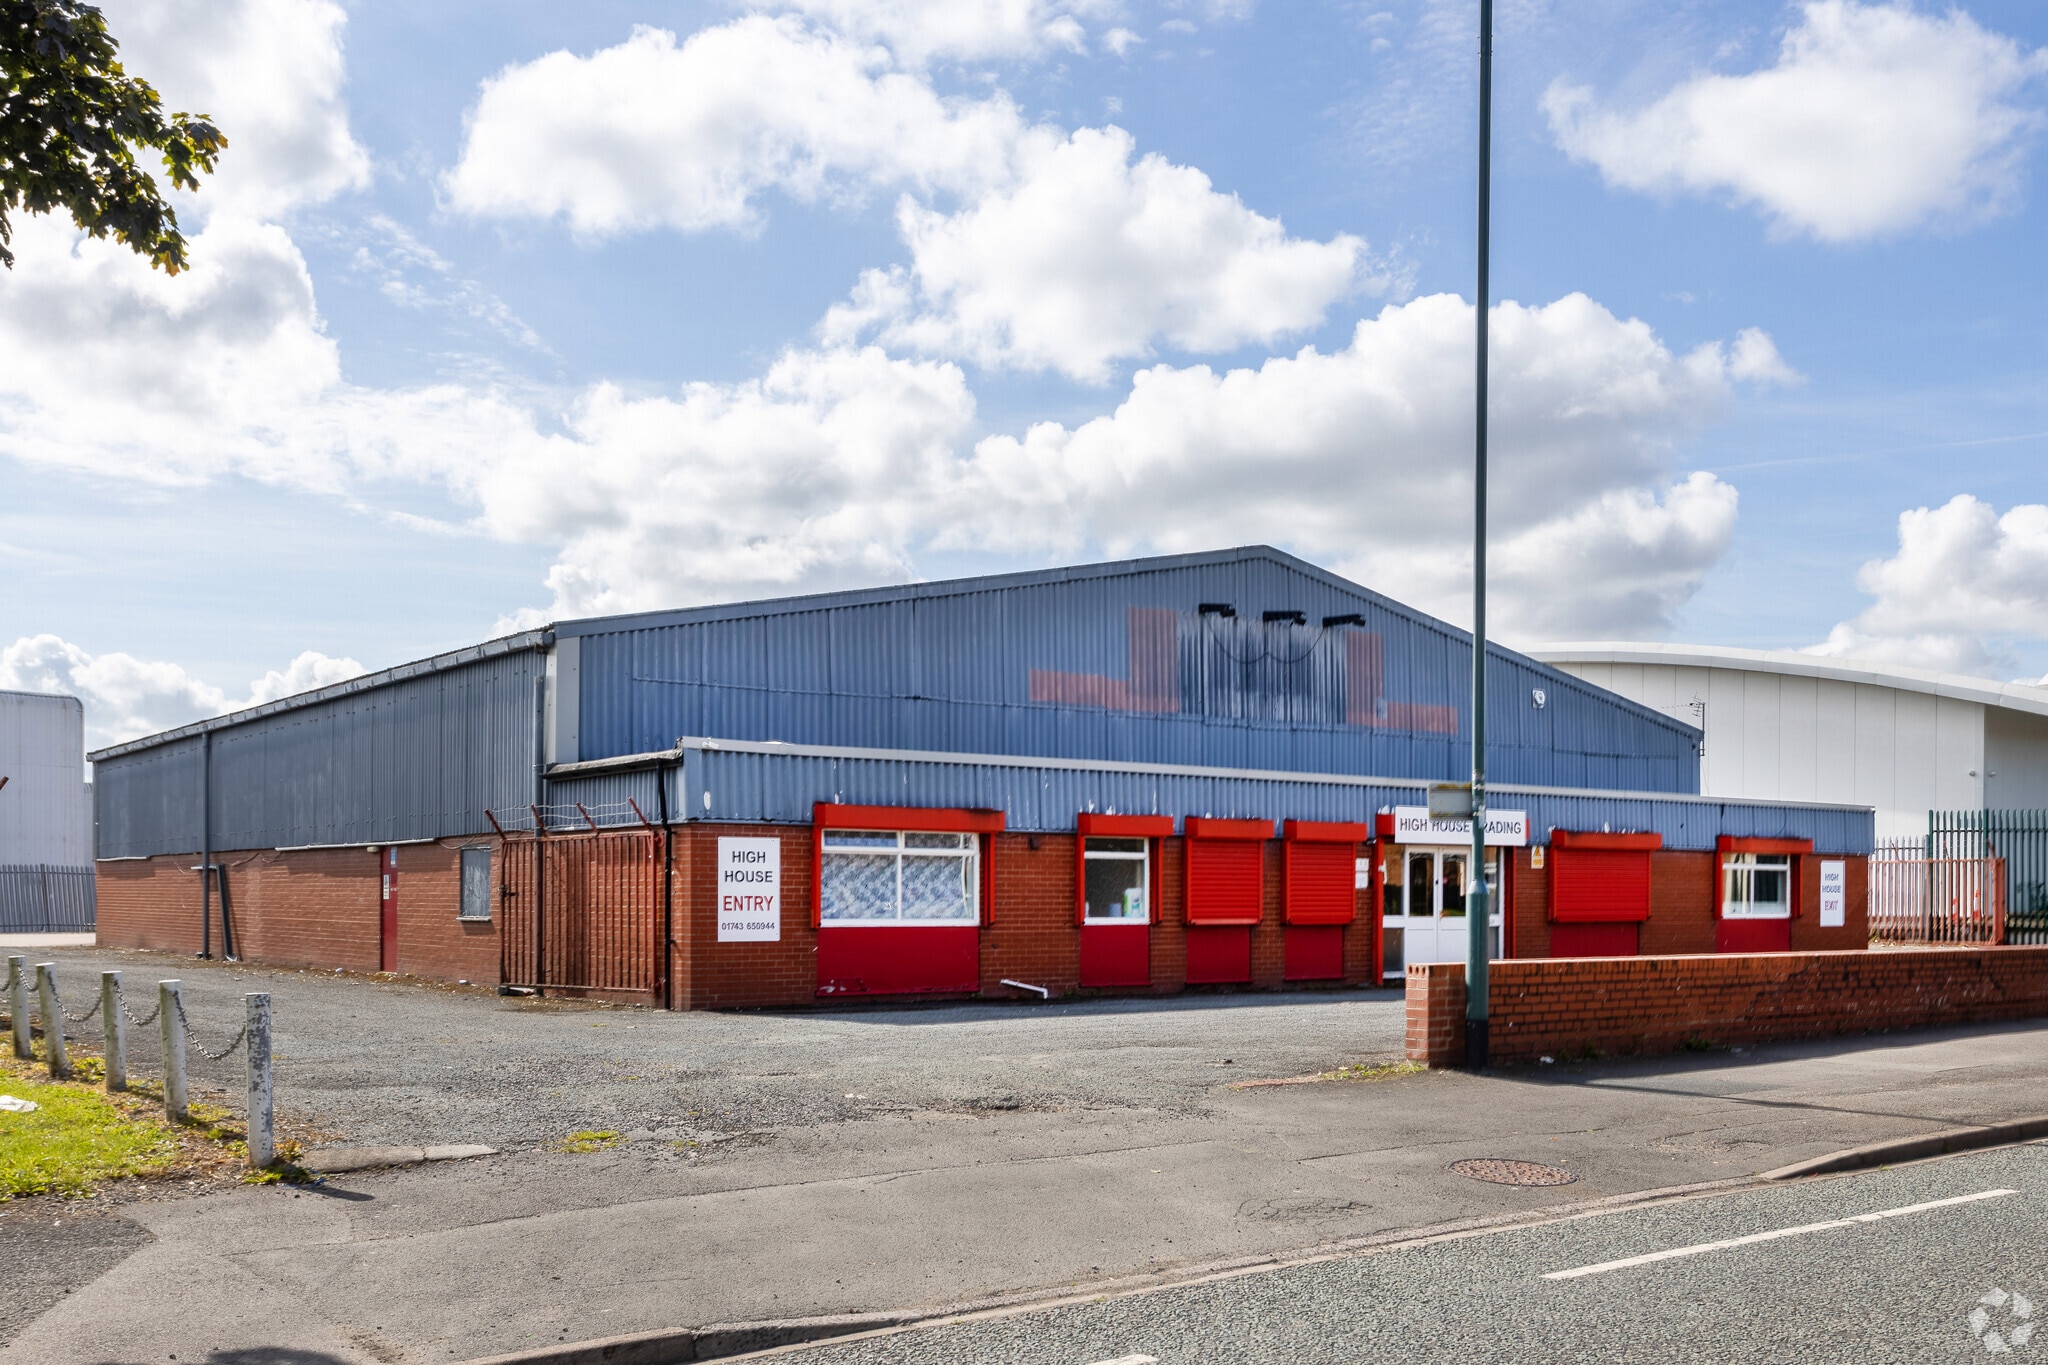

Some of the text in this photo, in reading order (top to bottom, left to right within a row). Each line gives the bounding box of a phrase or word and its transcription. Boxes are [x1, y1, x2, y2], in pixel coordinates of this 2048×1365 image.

[1399, 818, 1428, 832] HIGH
[1432, 819, 1471, 833] HOUSE
[731, 850, 766, 863] HIGH
[724, 870, 773, 883] HOUSE
[1824, 873, 1839, 881] HIGH
[1822, 885, 1841, 893] HOUSE
[723, 895, 774, 911] ENTRY
[1824, 900, 1839, 910] EXIT
[721, 922, 744, 930] 01743
